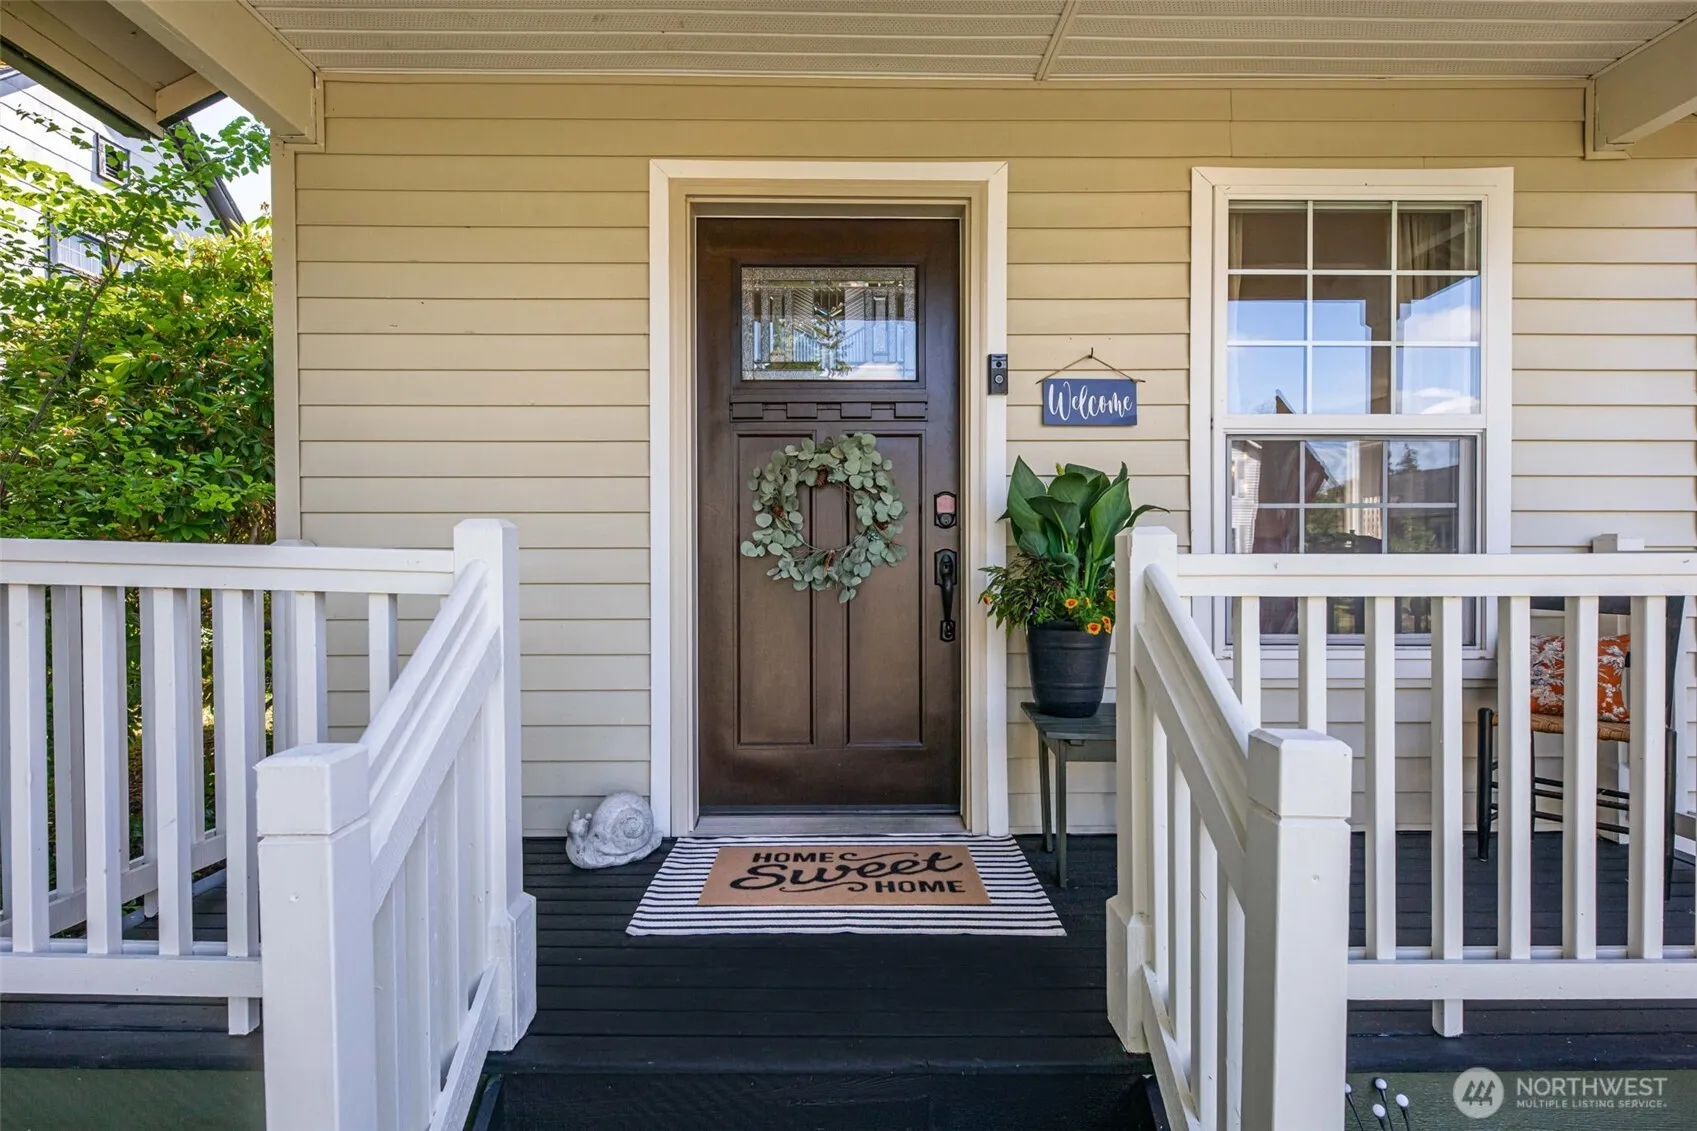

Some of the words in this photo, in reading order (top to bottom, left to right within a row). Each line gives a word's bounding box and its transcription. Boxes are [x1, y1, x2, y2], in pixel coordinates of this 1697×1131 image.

[1049, 381, 1133, 421] Welcome
[752, 852, 835, 863] HOME
[729, 851, 964, 891] Sweet
[875, 880, 966, 893] HOME
